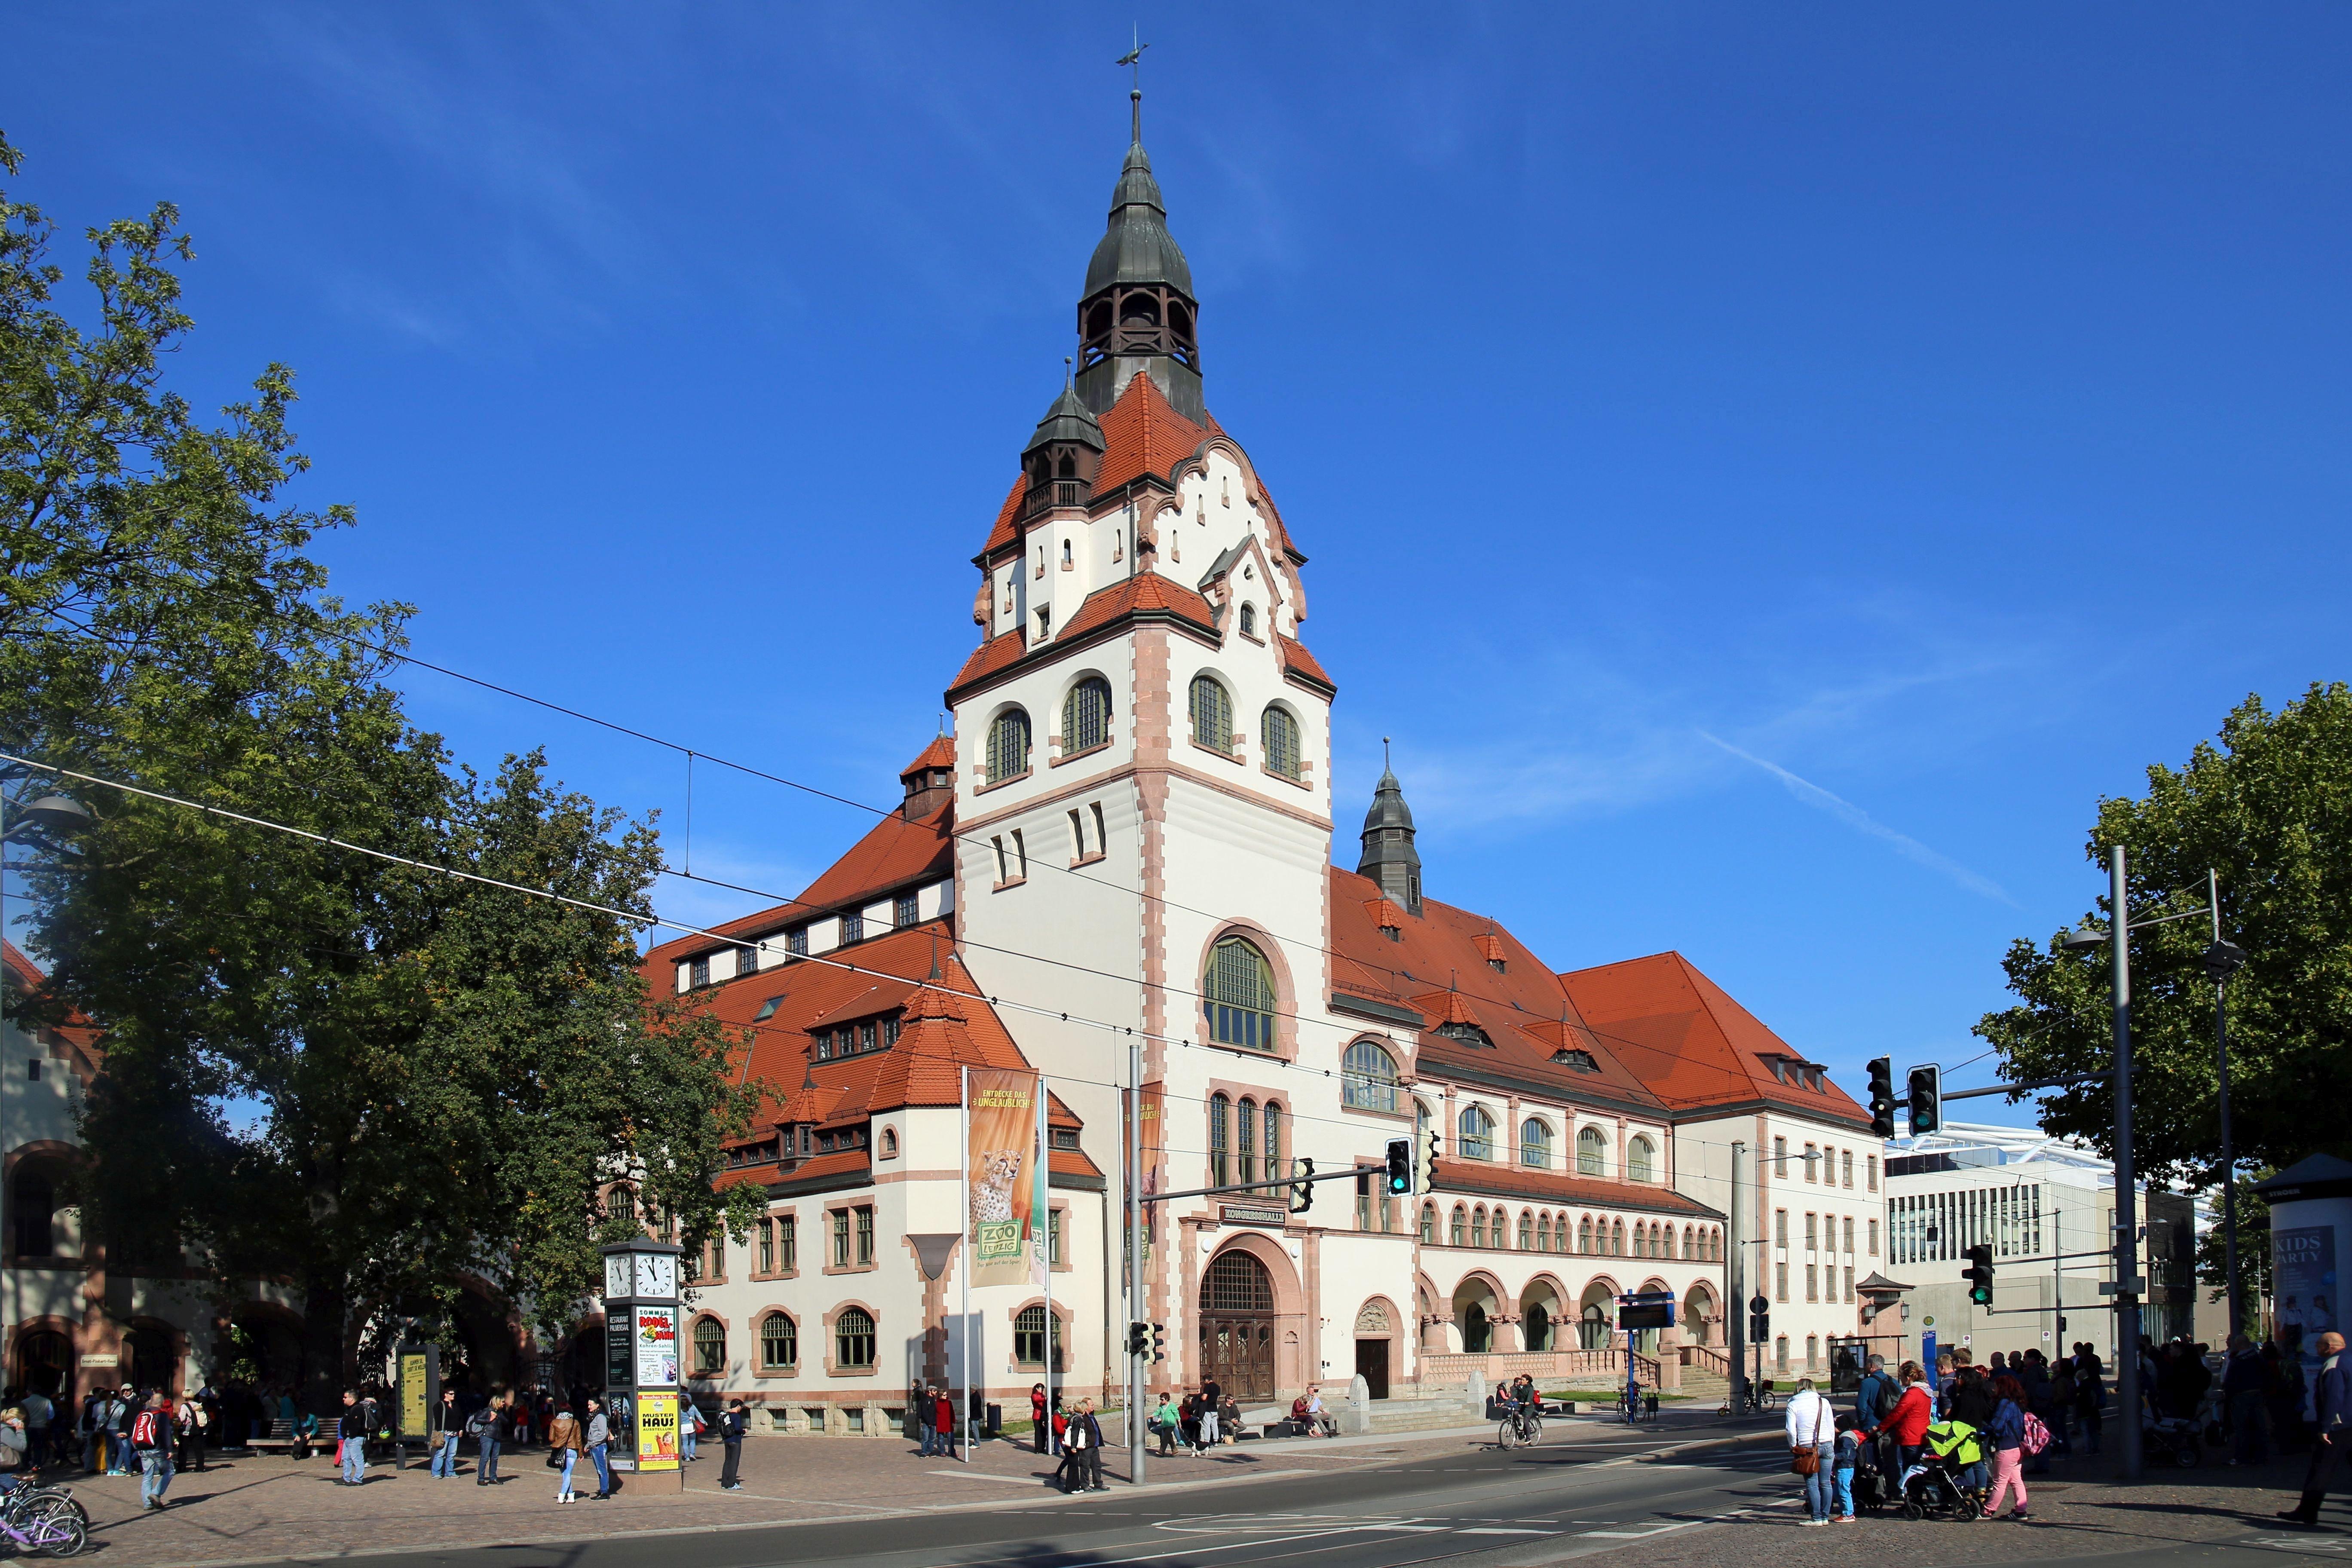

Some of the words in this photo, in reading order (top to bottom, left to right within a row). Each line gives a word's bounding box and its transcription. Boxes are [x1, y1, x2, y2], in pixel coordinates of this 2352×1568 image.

[983, 1090, 1013, 1098] ENTDECKE
[978, 1097, 1031, 1108] UNGLAUBLICH!
[1225, 1209, 1284, 1222] KONGRESSHALLE
[983, 1225, 1016, 1240] ZOO
[983, 1242, 1015, 1253] LEIPZIG
[2275, 1236, 2321, 1252] KIDS
[2275, 1251, 2321, 1264] PARTY
[609, 1315, 628, 1323] RESTAURANT
[639, 1317, 673, 1329] RODEL-
[643, 1418, 674, 1427] HAUS
